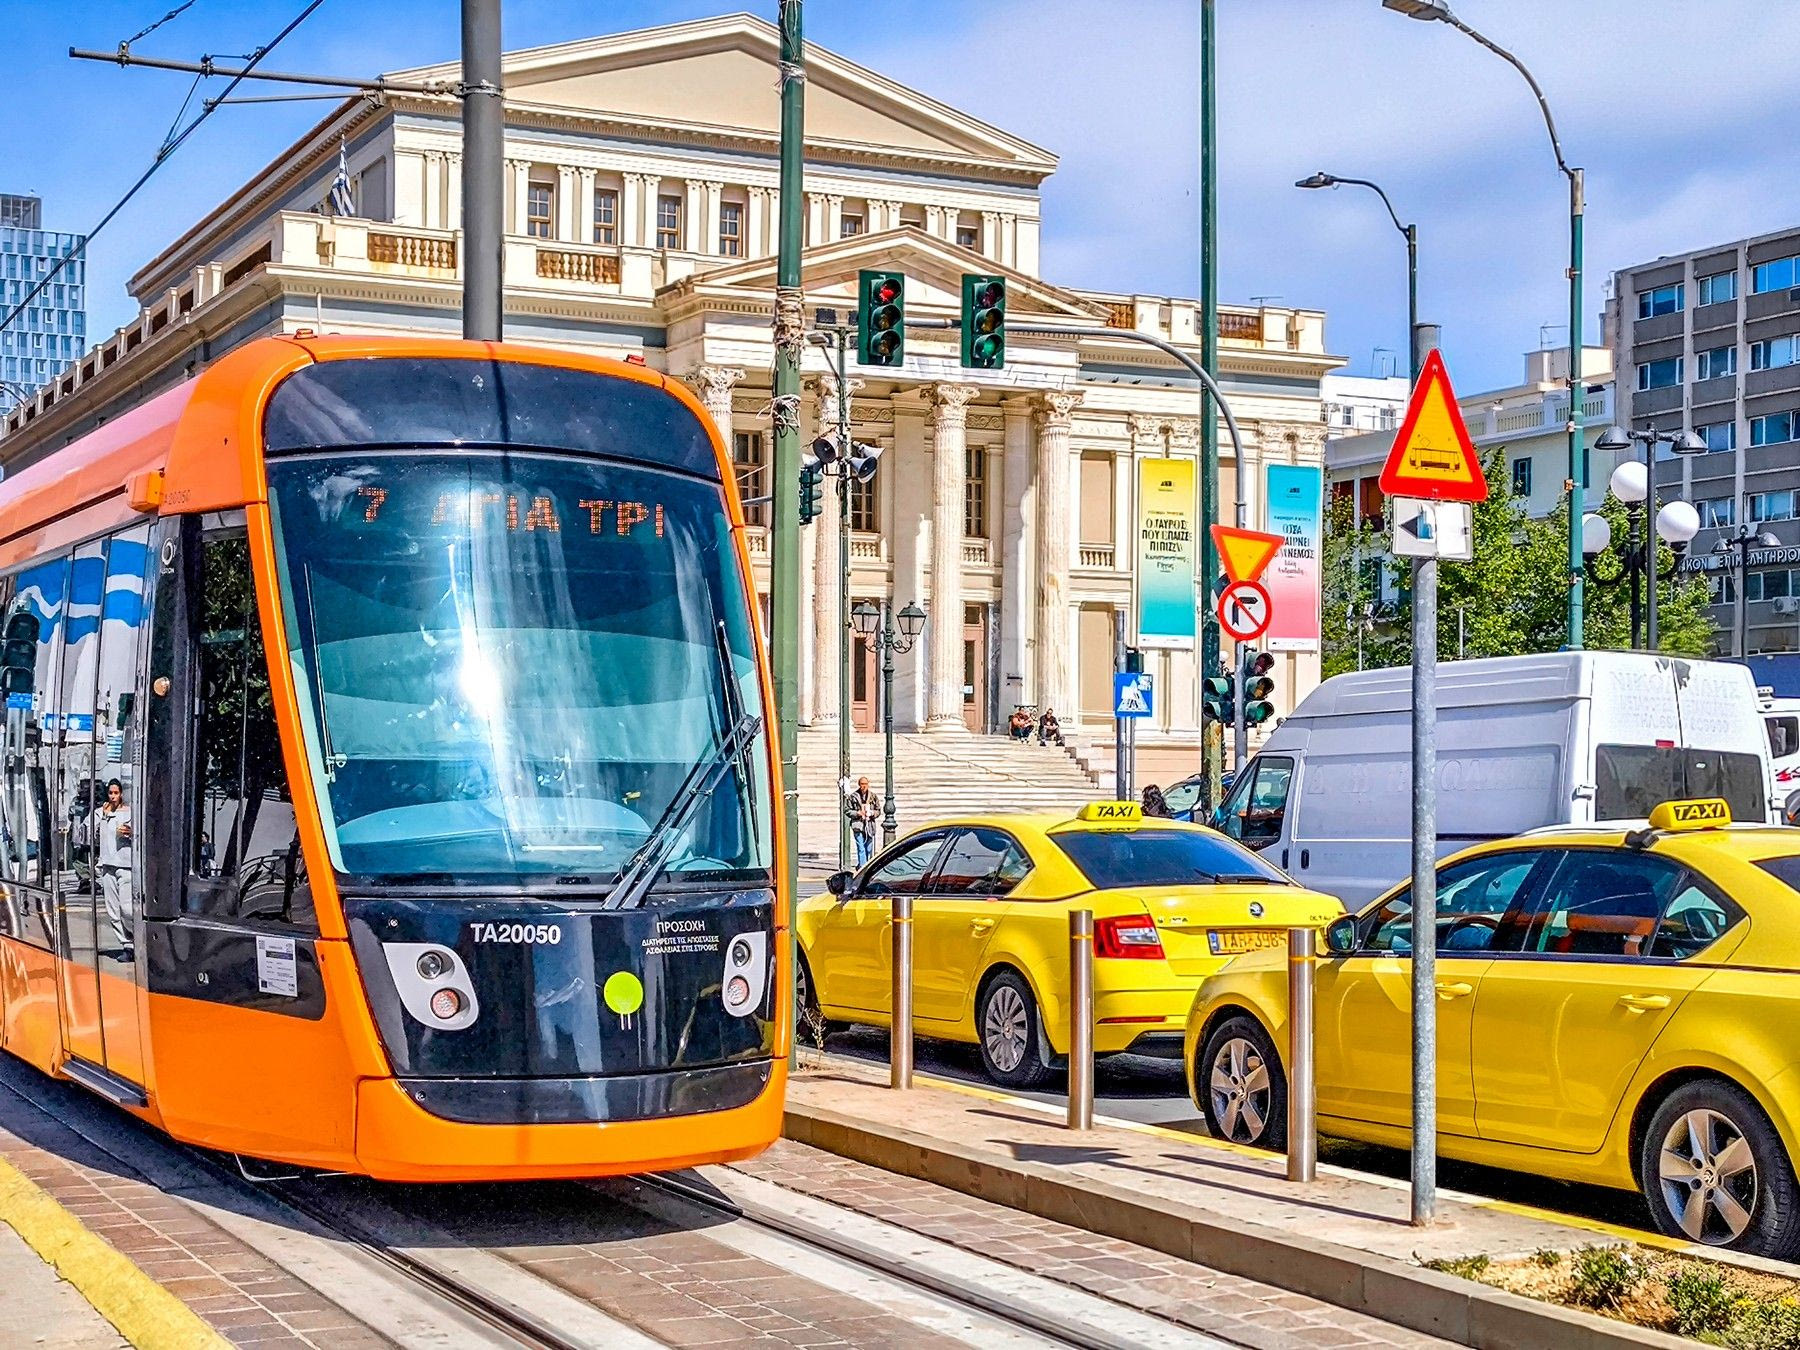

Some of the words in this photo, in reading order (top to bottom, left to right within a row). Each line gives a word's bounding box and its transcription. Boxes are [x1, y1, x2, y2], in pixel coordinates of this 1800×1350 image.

[357, 486, 390, 523] 7
[1142, 529, 1160, 541] ΠΟΥ
[1283, 536, 1310, 547] ΑΙΡΝΕΙ
[1096, 805, 1134, 818] TAXI
[1675, 803, 1723, 820] TAXI
[656, 919, 706, 933] ΠΡΟΣΟΧΗ
[469, 922, 562, 945] TA20050
